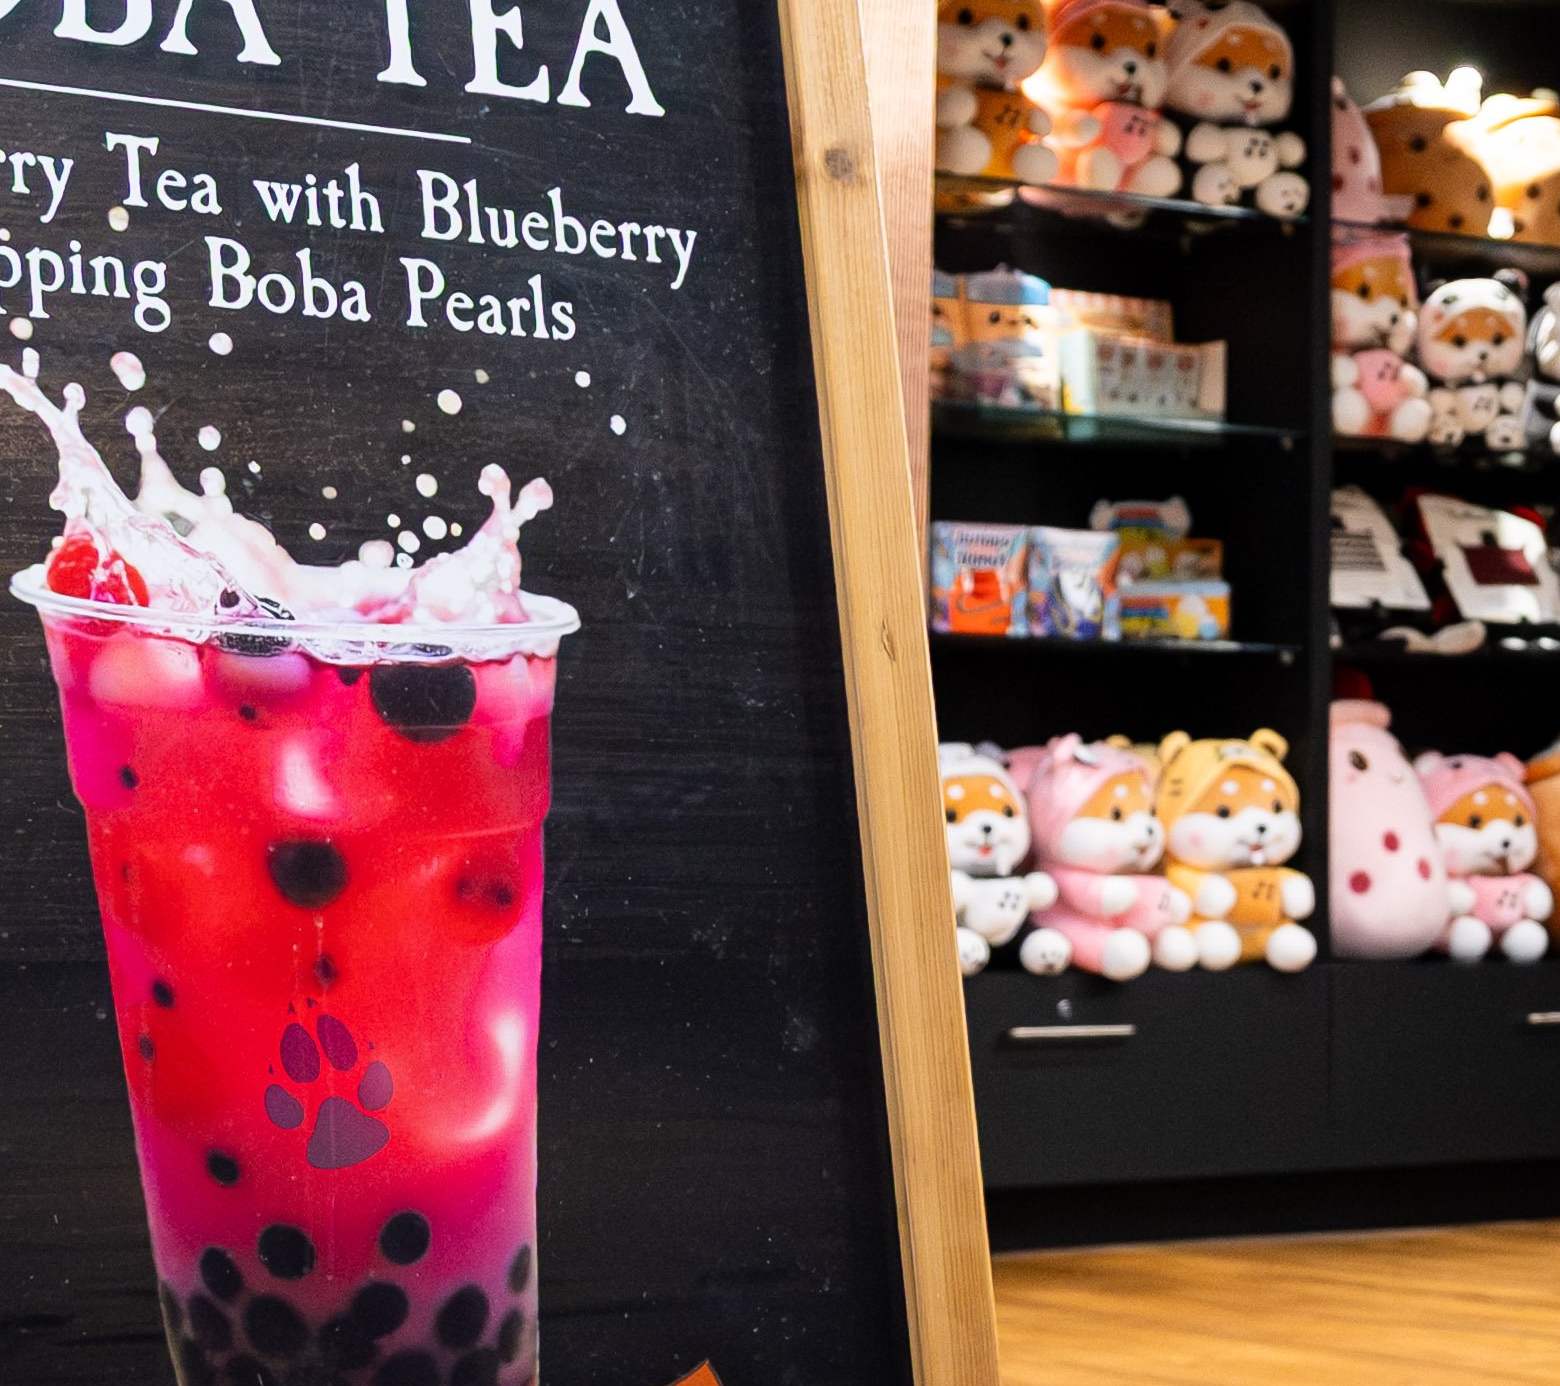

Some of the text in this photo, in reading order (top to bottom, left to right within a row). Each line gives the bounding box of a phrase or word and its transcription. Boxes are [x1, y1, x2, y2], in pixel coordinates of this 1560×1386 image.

[105, 131, 223, 216] Tea
[252, 162, 385, 234] with
[416, 169, 698, 290] Blueberry
[204, 235, 372, 323] Boba
[399, 256, 576, 341] Pearls
